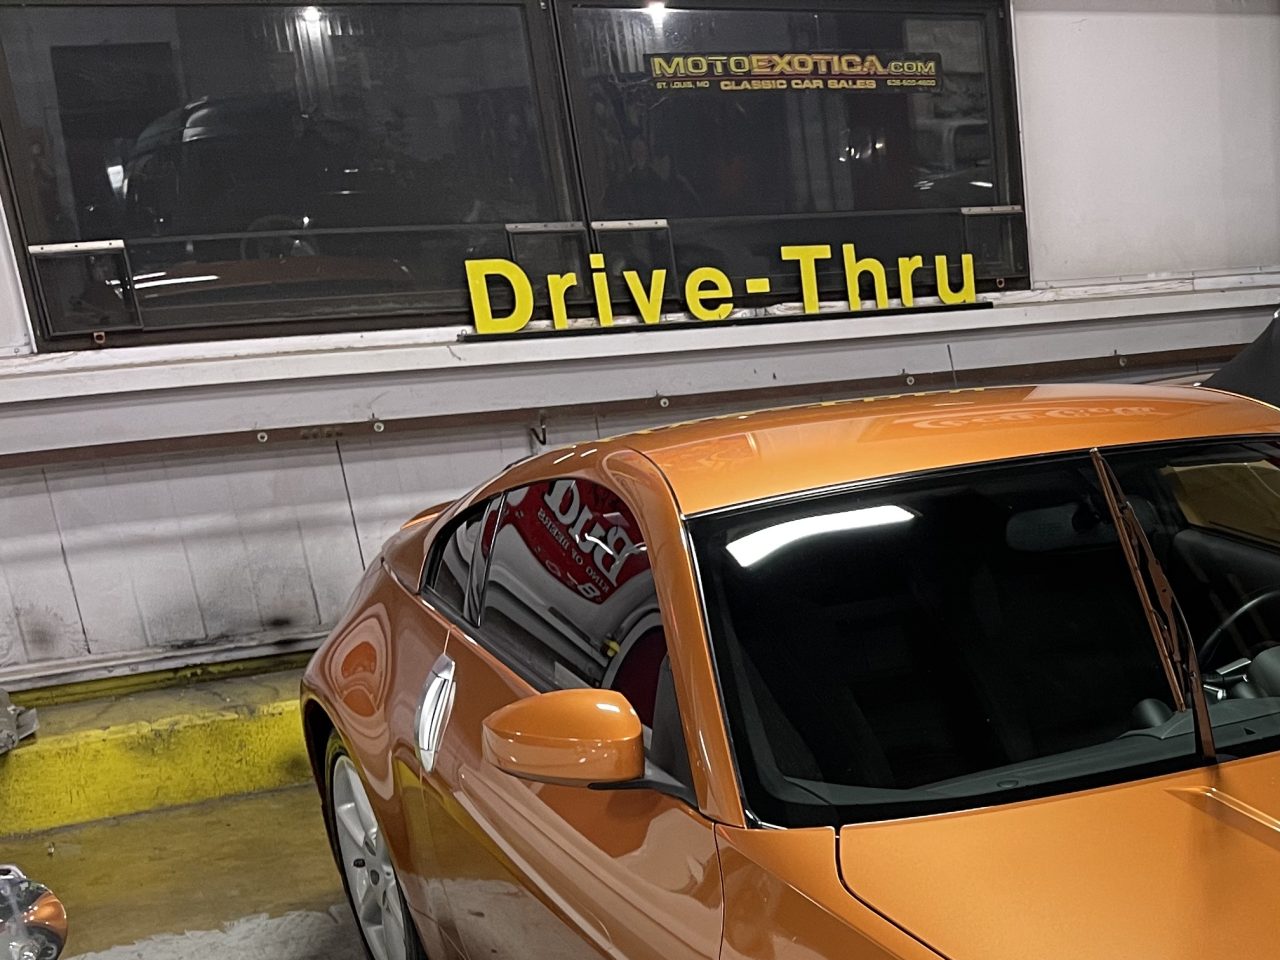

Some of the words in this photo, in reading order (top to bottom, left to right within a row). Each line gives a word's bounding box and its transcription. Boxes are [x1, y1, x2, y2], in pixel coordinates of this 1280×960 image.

[720, 79, 788, 91] CLASSIC
[791, 79, 824, 90] CAR
[827, 79, 877, 89] SALES
[464, 243, 977, 335] Drive-Thru
